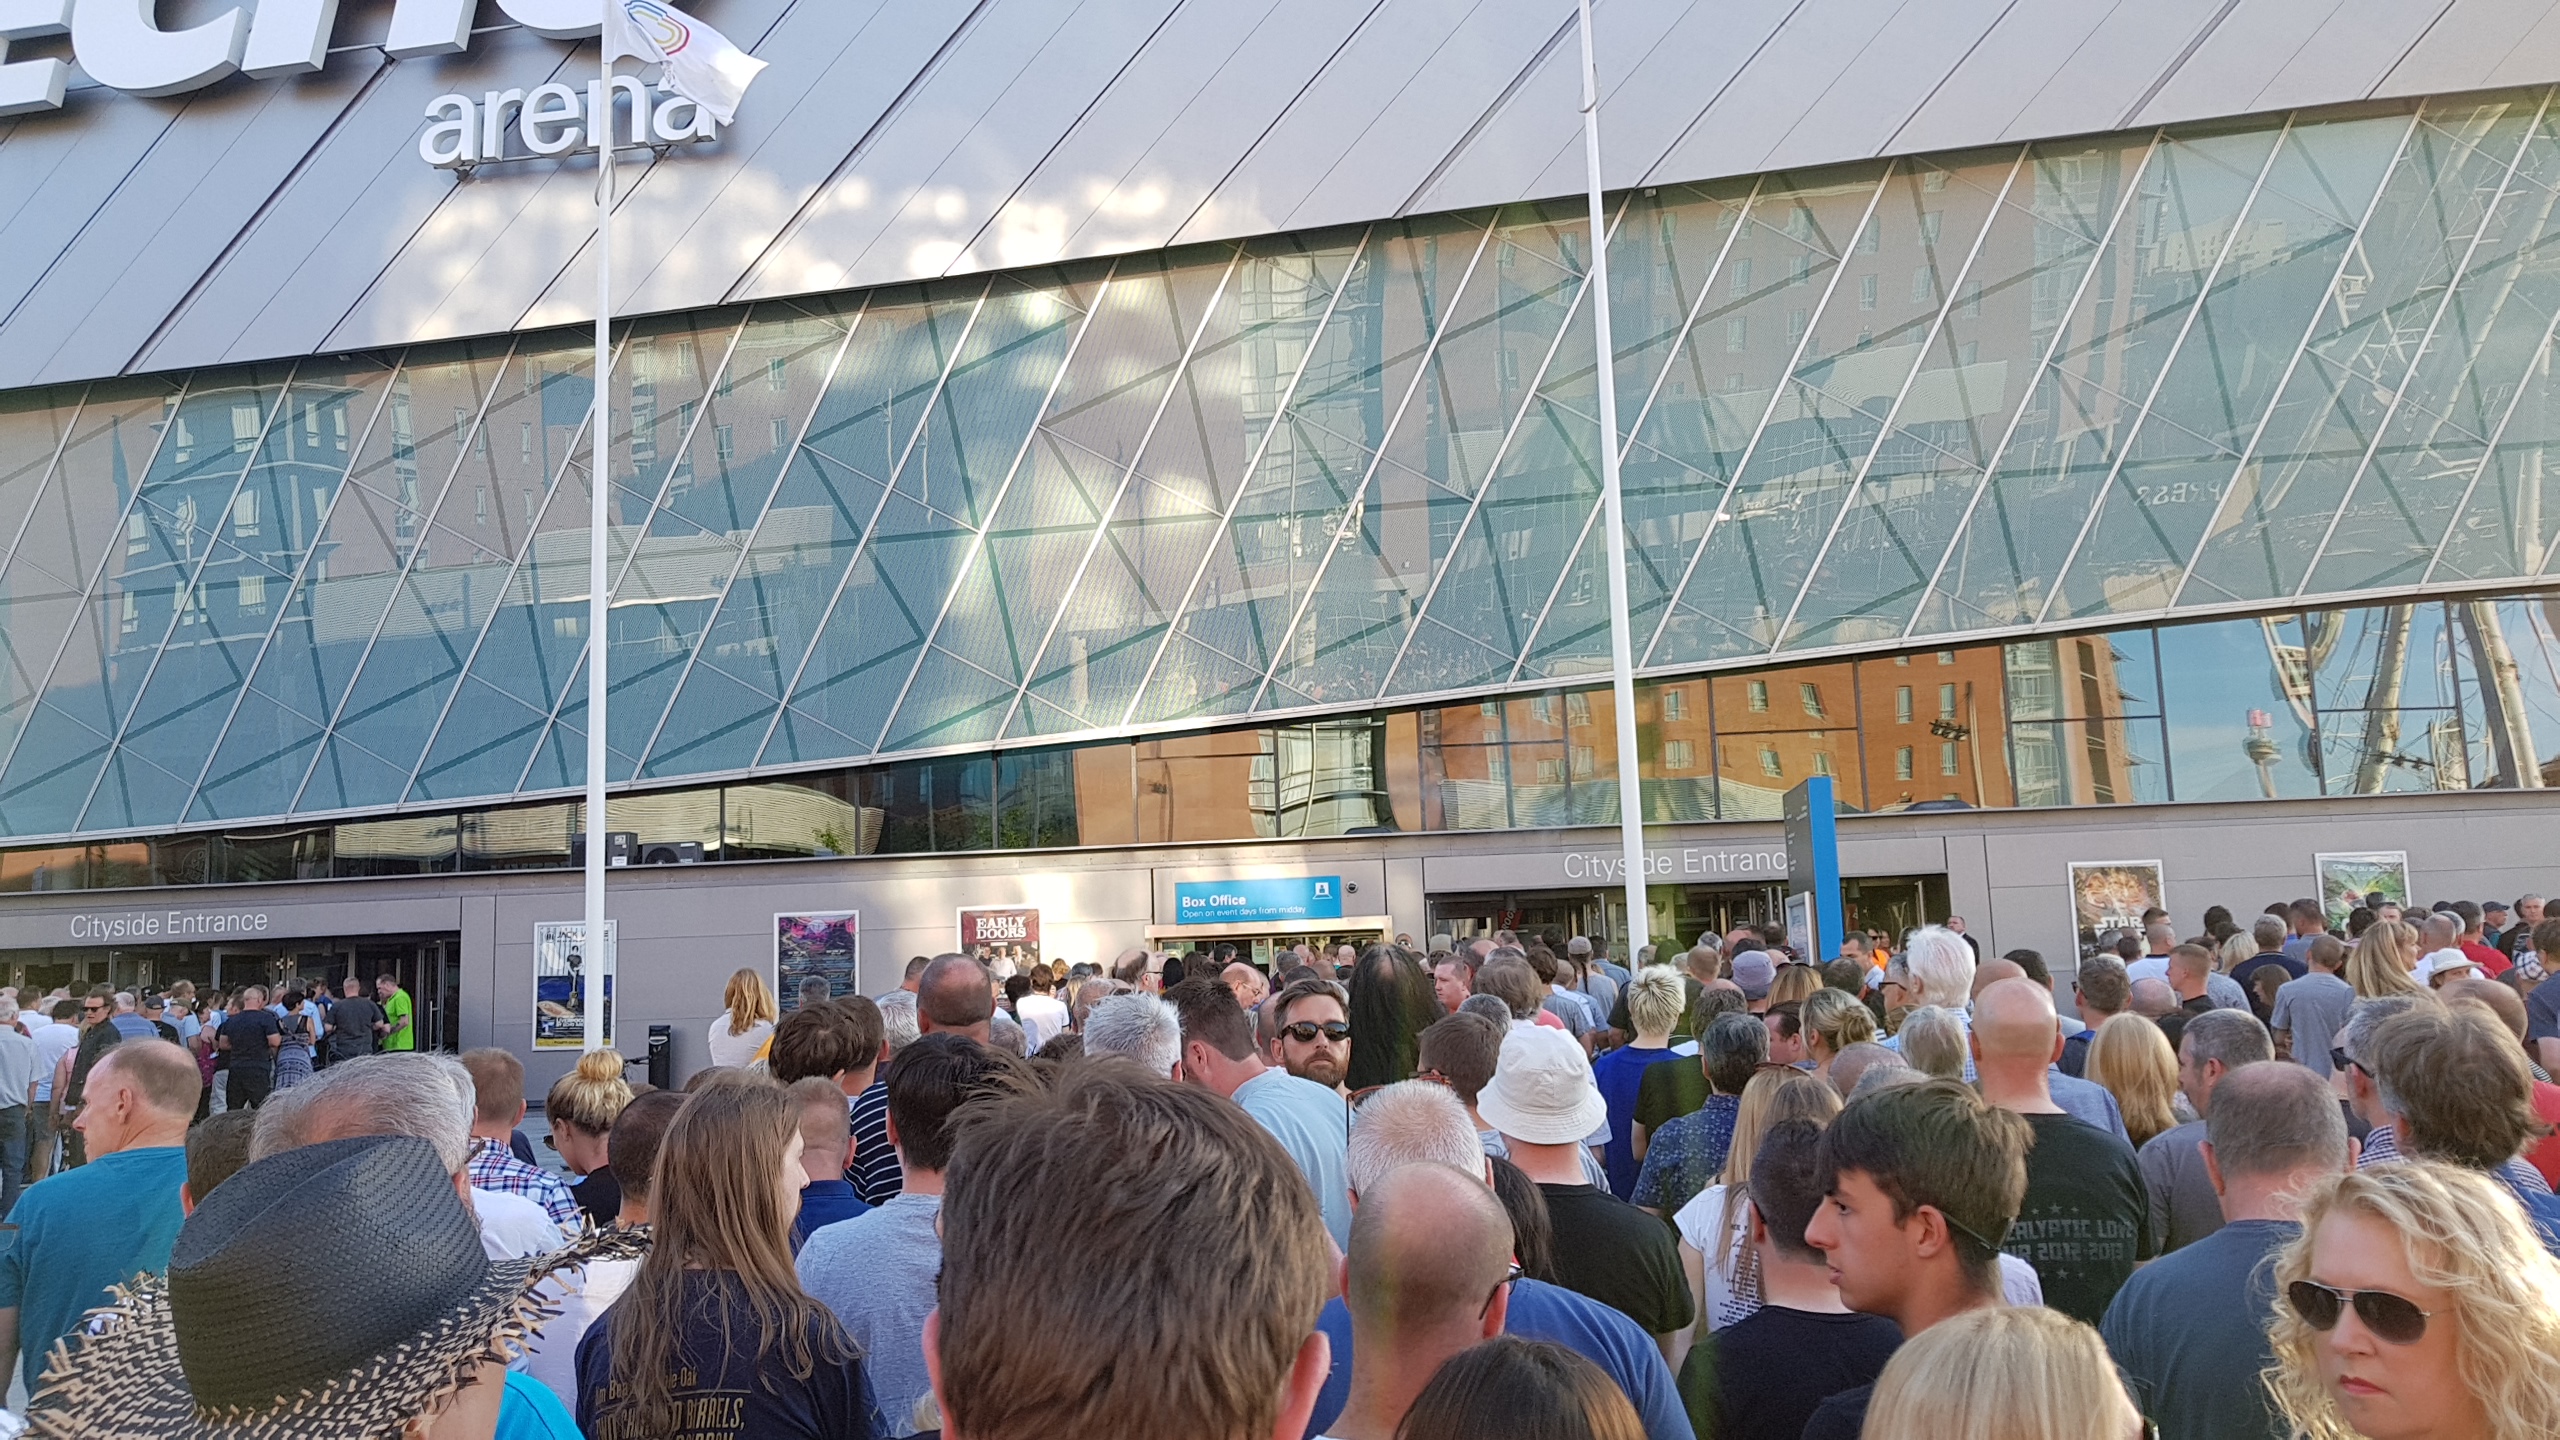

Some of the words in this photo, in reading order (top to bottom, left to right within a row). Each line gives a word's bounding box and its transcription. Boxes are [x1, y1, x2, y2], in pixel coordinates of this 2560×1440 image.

[419, 75, 716, 166] arena
[1563, 851, 1673, 882] Citysde
[1683, 848, 1788, 874] Entranc
[1182, 896, 1206, 908] Box
[1209, 894, 1247, 907] Office
[1182, 910, 1204, 919] Open
[1239, 908, 1257, 917] days
[1258, 907, 1277, 915] from
[1278, 906, 1306, 915] midday
[70, 913, 160, 942] Cityside
[167, 911, 269, 935] Entrance
[976, 916, 1026, 929] EARLY
[2094, 916, 2147, 929] STAR
[976, 927, 1027, 939] DOORS
